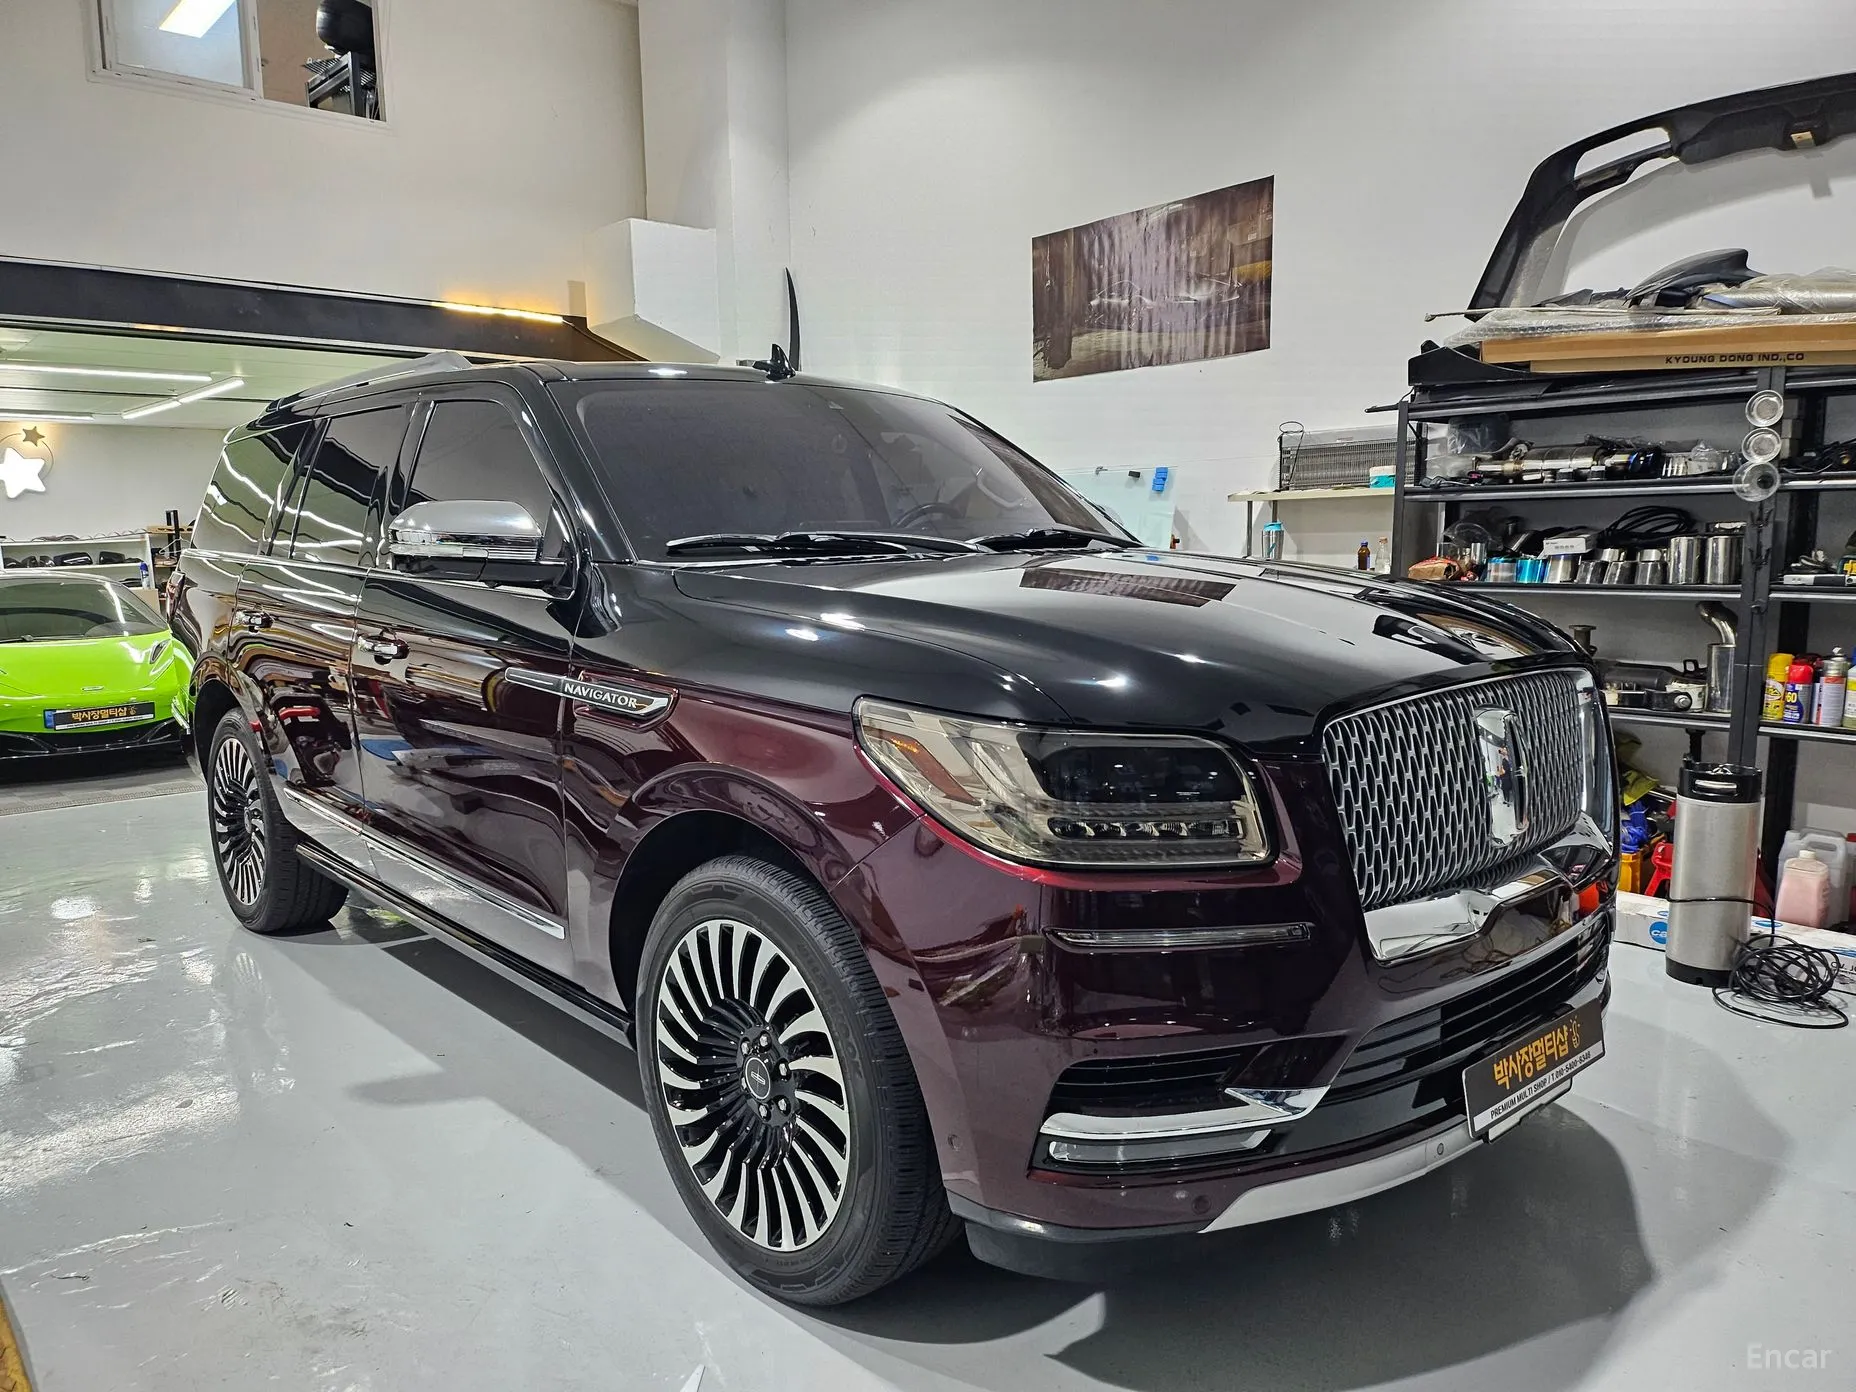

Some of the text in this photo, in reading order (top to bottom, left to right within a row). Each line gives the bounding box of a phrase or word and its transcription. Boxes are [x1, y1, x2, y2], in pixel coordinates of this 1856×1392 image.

[1665, 355, 1715, 364] KYOUNG
[1719, 354, 1754, 363] DONG
[564, 682, 637, 708] NAVIGATOR
[71, 706, 127, 721] 박사장멀티샵
[1494, 1024, 1569, 1090] 박사장멀티샵
[1491, 1096, 1516, 1119] PREMIUM
[1516, 1086, 1534, 1104] MULTI
[1534, 1077, 1548, 1093] SHOP
